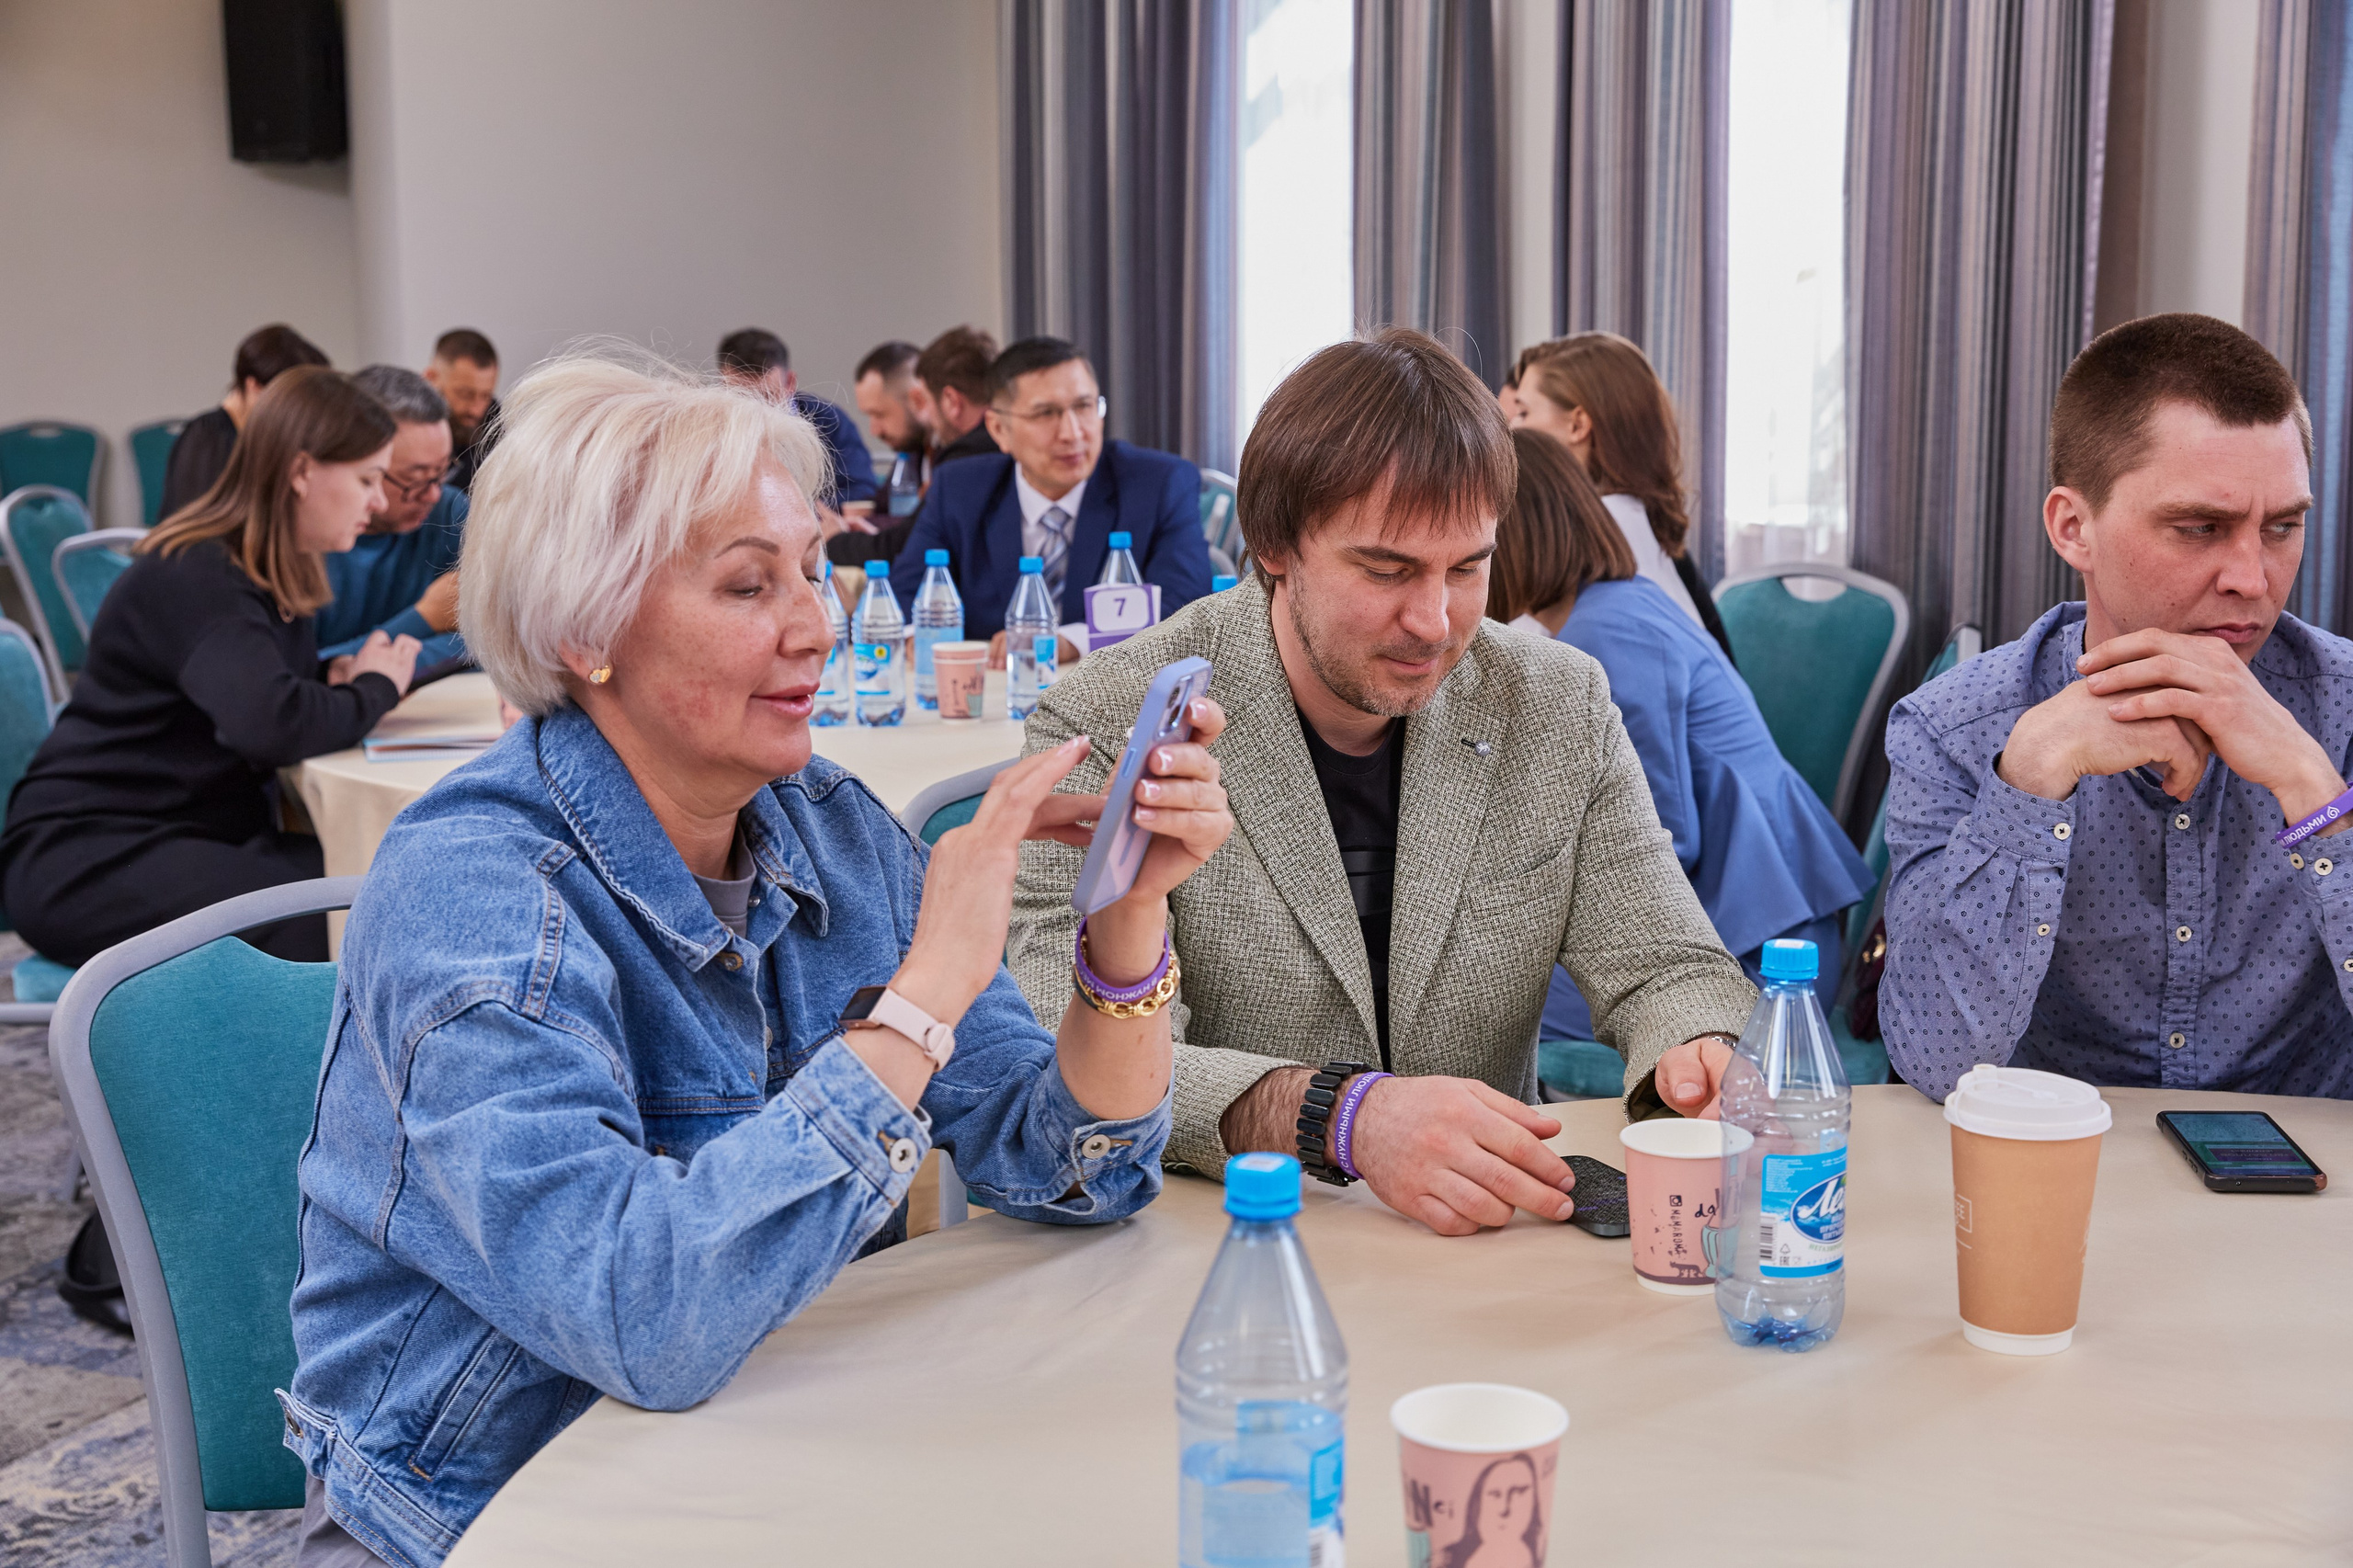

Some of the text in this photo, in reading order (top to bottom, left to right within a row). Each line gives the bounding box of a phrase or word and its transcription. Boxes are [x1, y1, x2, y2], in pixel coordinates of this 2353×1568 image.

[1114, 597, 1126, 617] 7
[2283, 814, 2327, 845] ЛЮДЬМИ
[1095, 983, 1151, 1001] НУЖНОМ
[1337, 1098, 1356, 1161] НУЖНЫМИ
[1351, 1071, 1379, 1097] ЛЮДЬ
